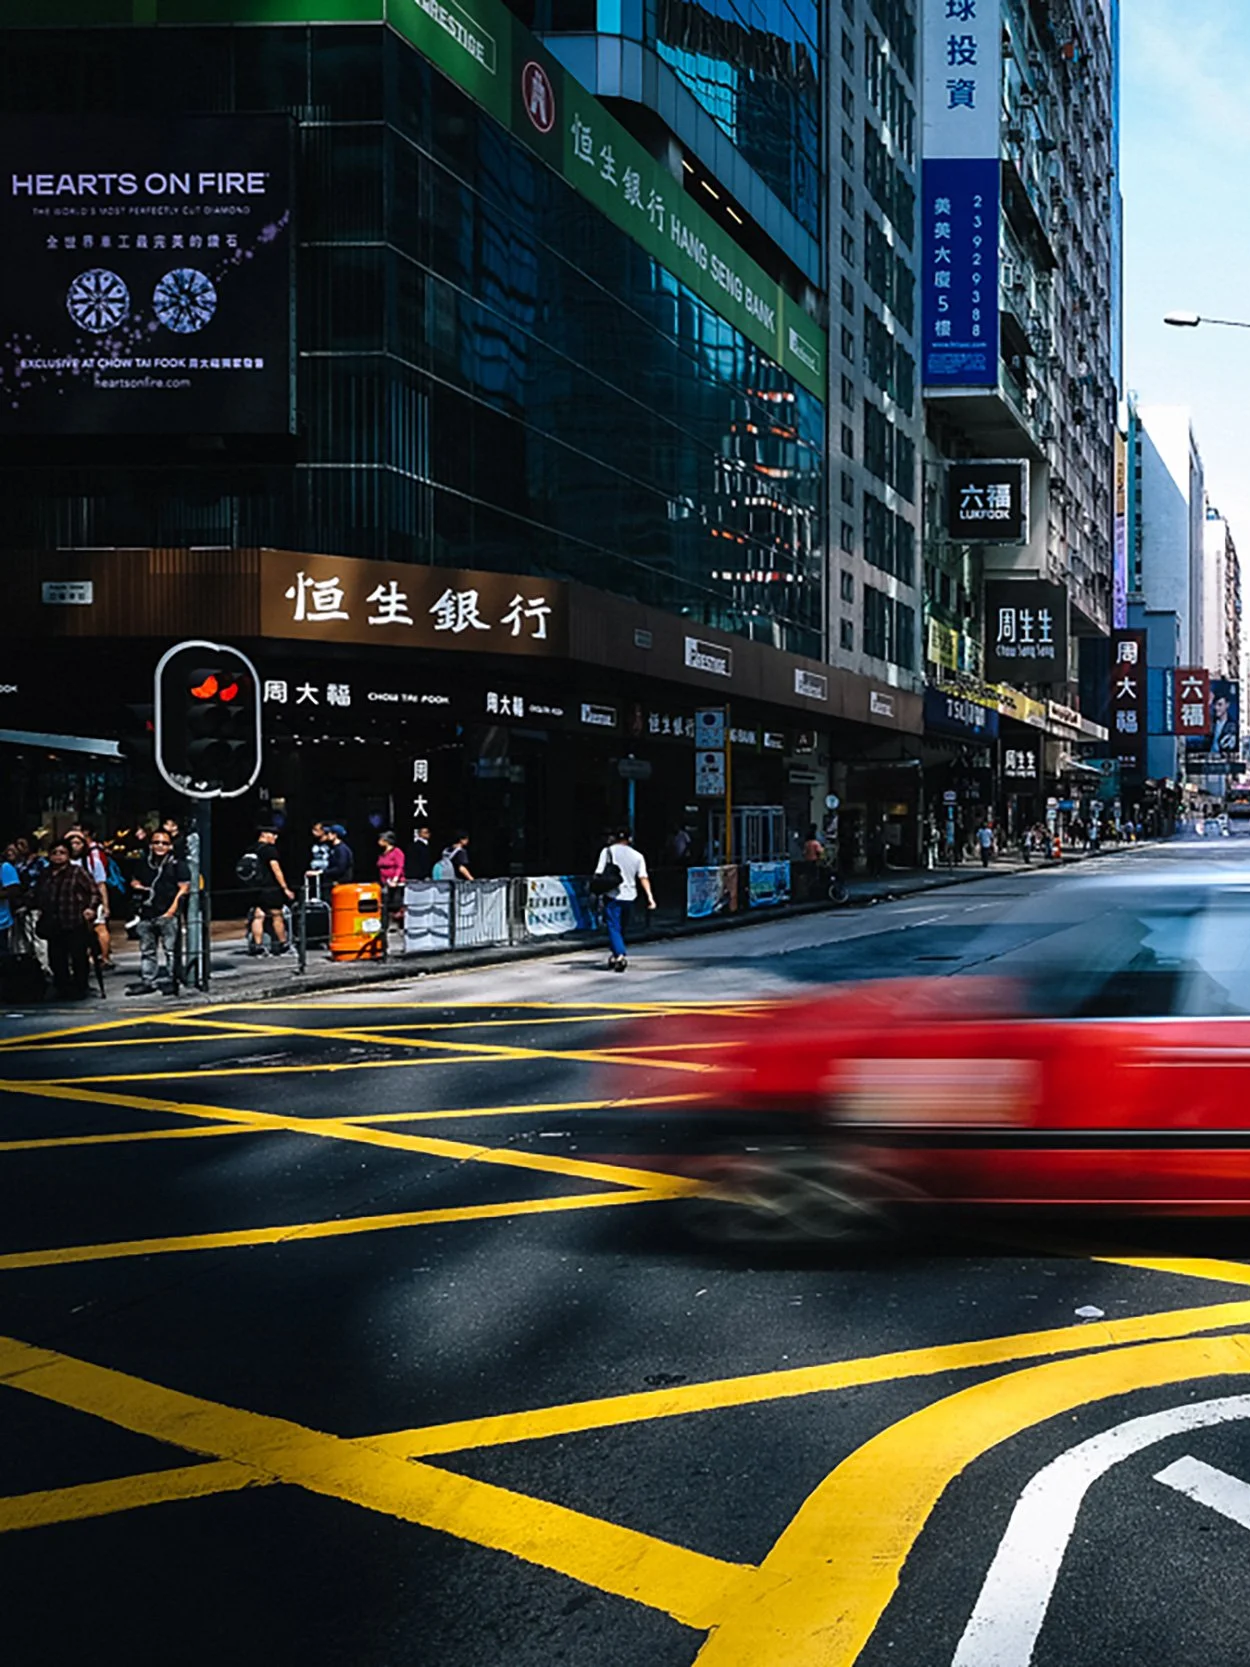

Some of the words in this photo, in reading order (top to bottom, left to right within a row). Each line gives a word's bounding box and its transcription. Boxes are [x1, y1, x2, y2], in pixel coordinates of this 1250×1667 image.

[12, 173, 138, 195] HEARTS
[145, 173, 190, 194] ON
[571, 112, 665, 233] 恒生銀行
[670, 213, 708, 271] HANG
[710, 254, 743, 304] SENG
[745, 287, 776, 334] BANK
[81, 358, 95, 368] AT
[97, 357, 132, 368] CHOW
[135, 357, 152, 368] TAI
[154, 357, 186, 368] FOOK
[93, 373, 191, 388] heartsonfire.com
[960, 484, 1011, 509] 六福
[286, 570, 553, 640] 恒生銀行
[996, 608, 1053, 643] 周生生
[1181, 675, 1204, 727] 六福
[413, 759, 429, 843] 周大
